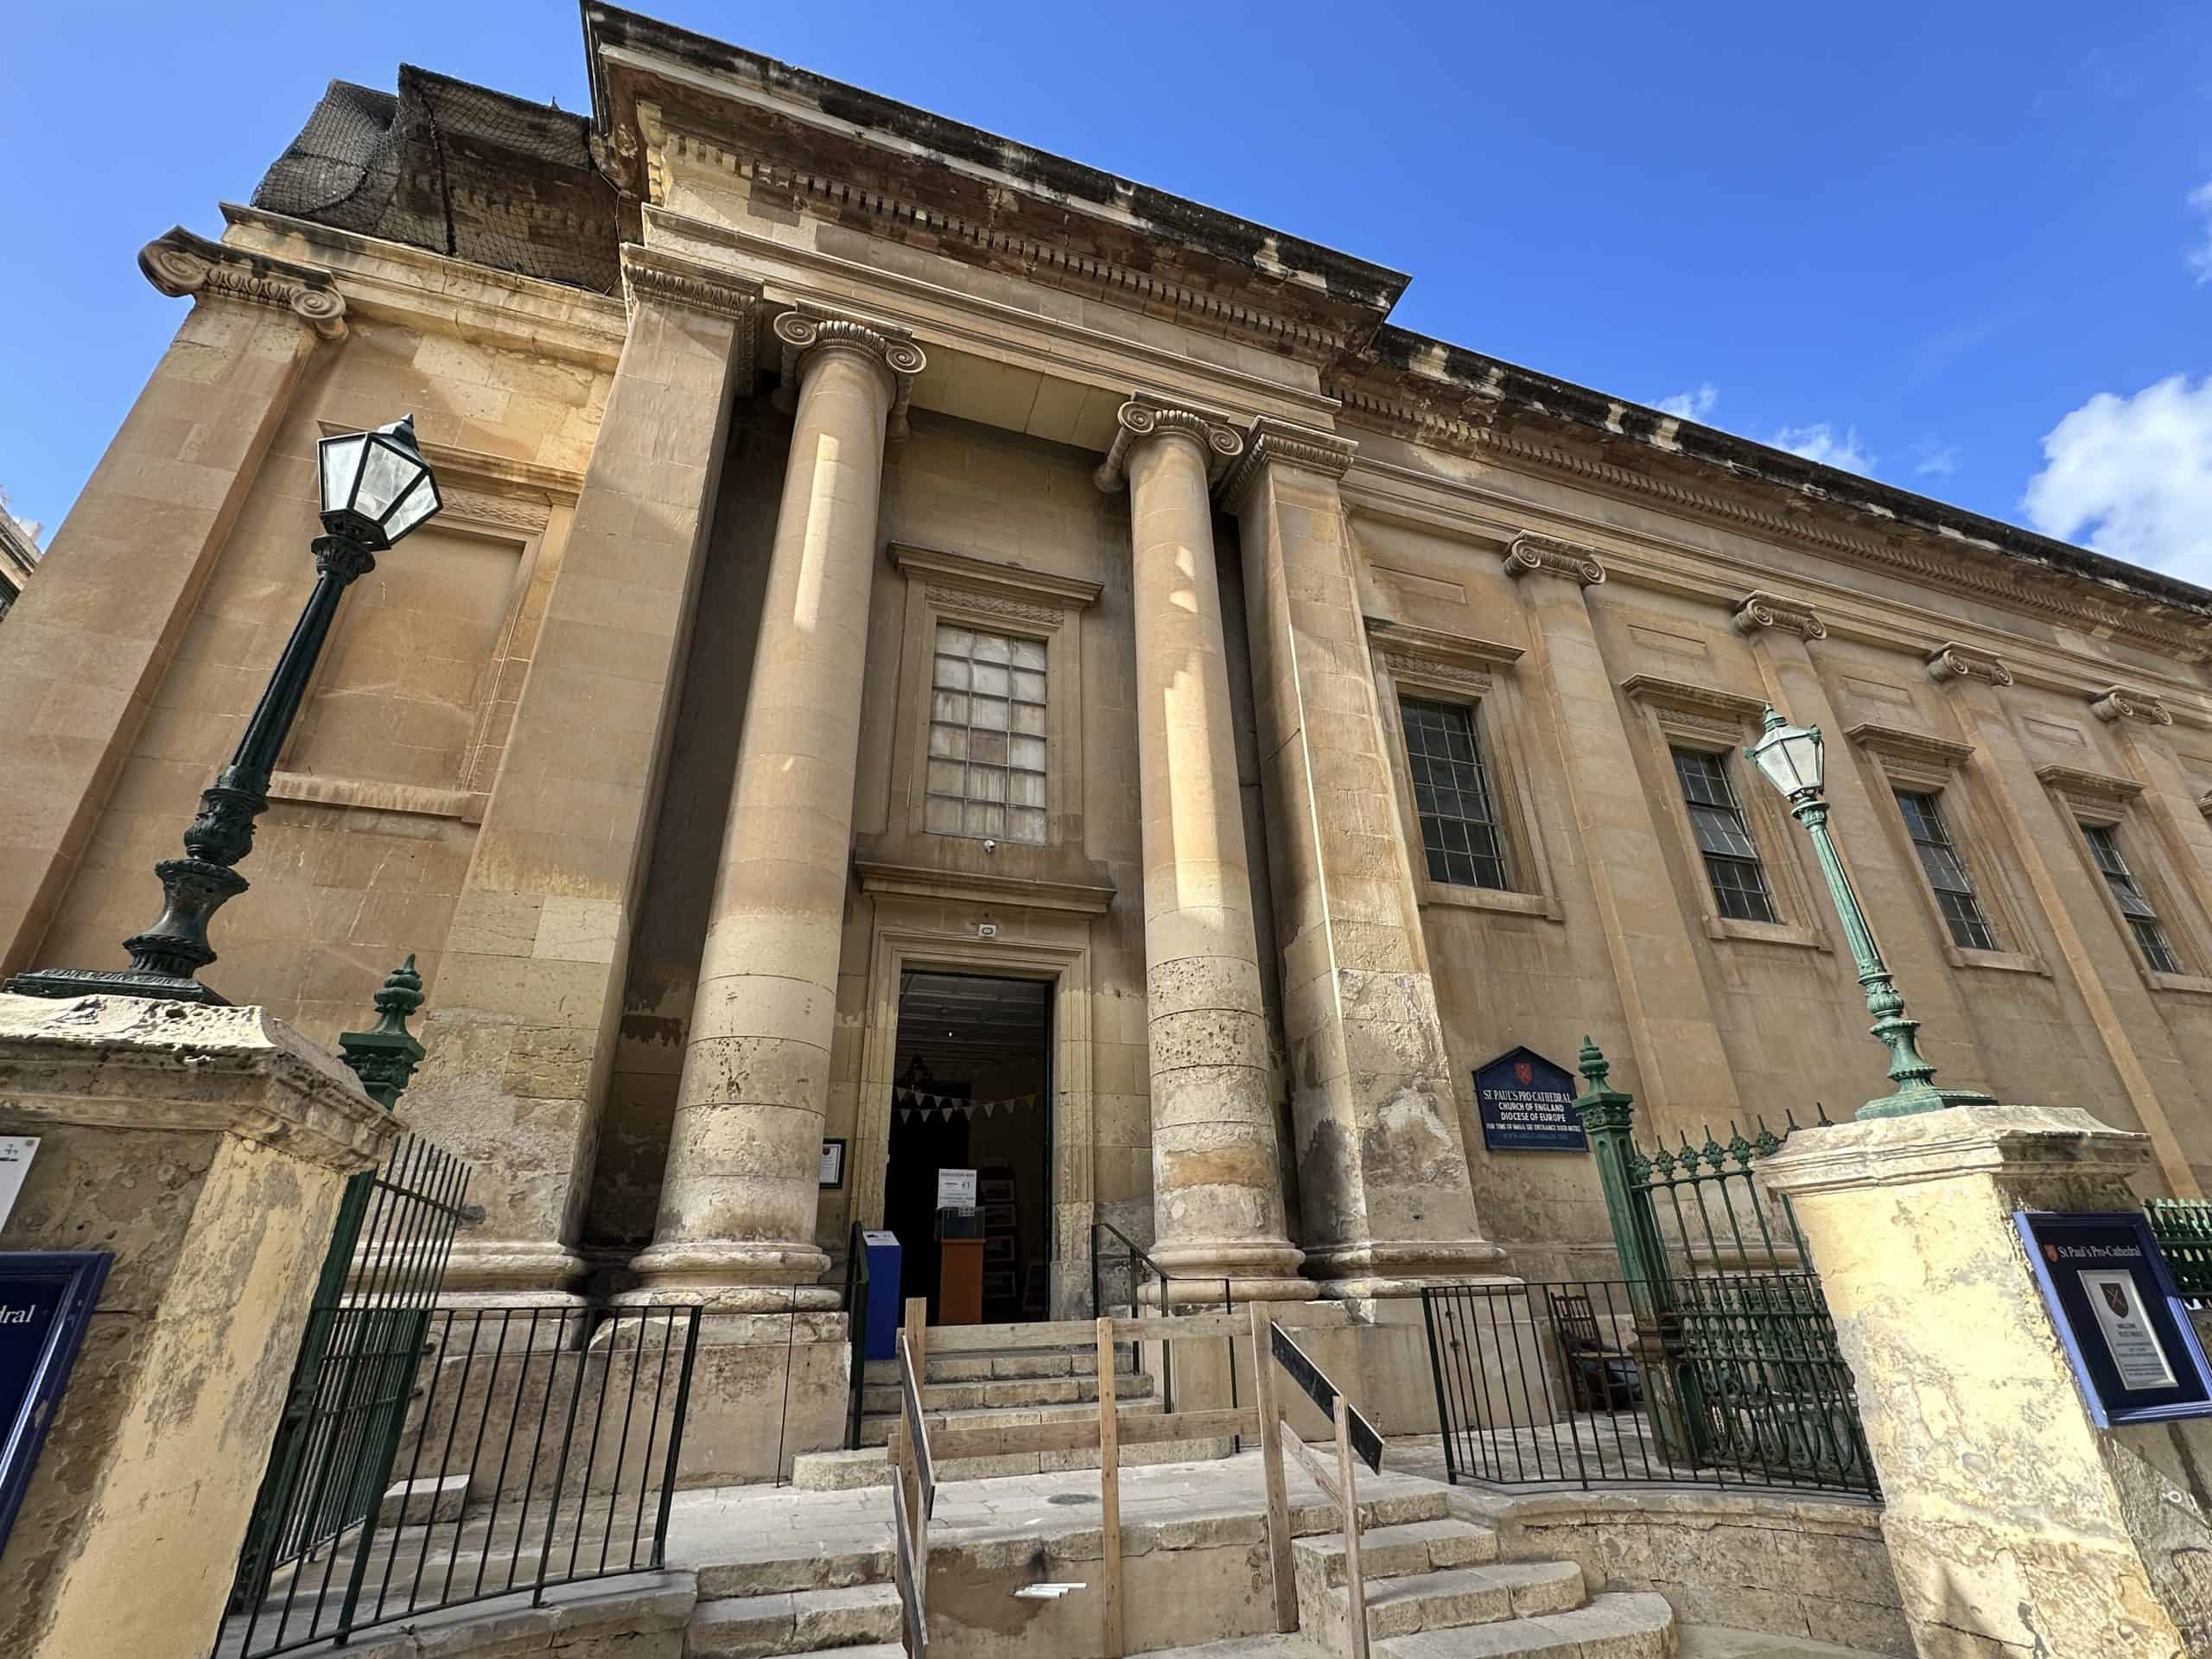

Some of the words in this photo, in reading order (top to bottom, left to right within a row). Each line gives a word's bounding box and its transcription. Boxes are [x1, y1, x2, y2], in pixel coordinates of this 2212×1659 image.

[1494, 1090, 1518, 1101] PAUL'S
[1498, 1102, 1524, 1111] CHURCH
[1525, 1103, 1534, 1111] OF
[1534, 1103, 1564, 1112] ENGLAND
[1501, 1112, 1529, 1121] DIOCESE
[1529, 1112, 1539, 1121] OF
[1539, 1113, 1567, 1122] EUROPE
[2068, 1245, 2091, 1258] Paul's
[2090, 1244, 2142, 1258] Pro-Cathedral
